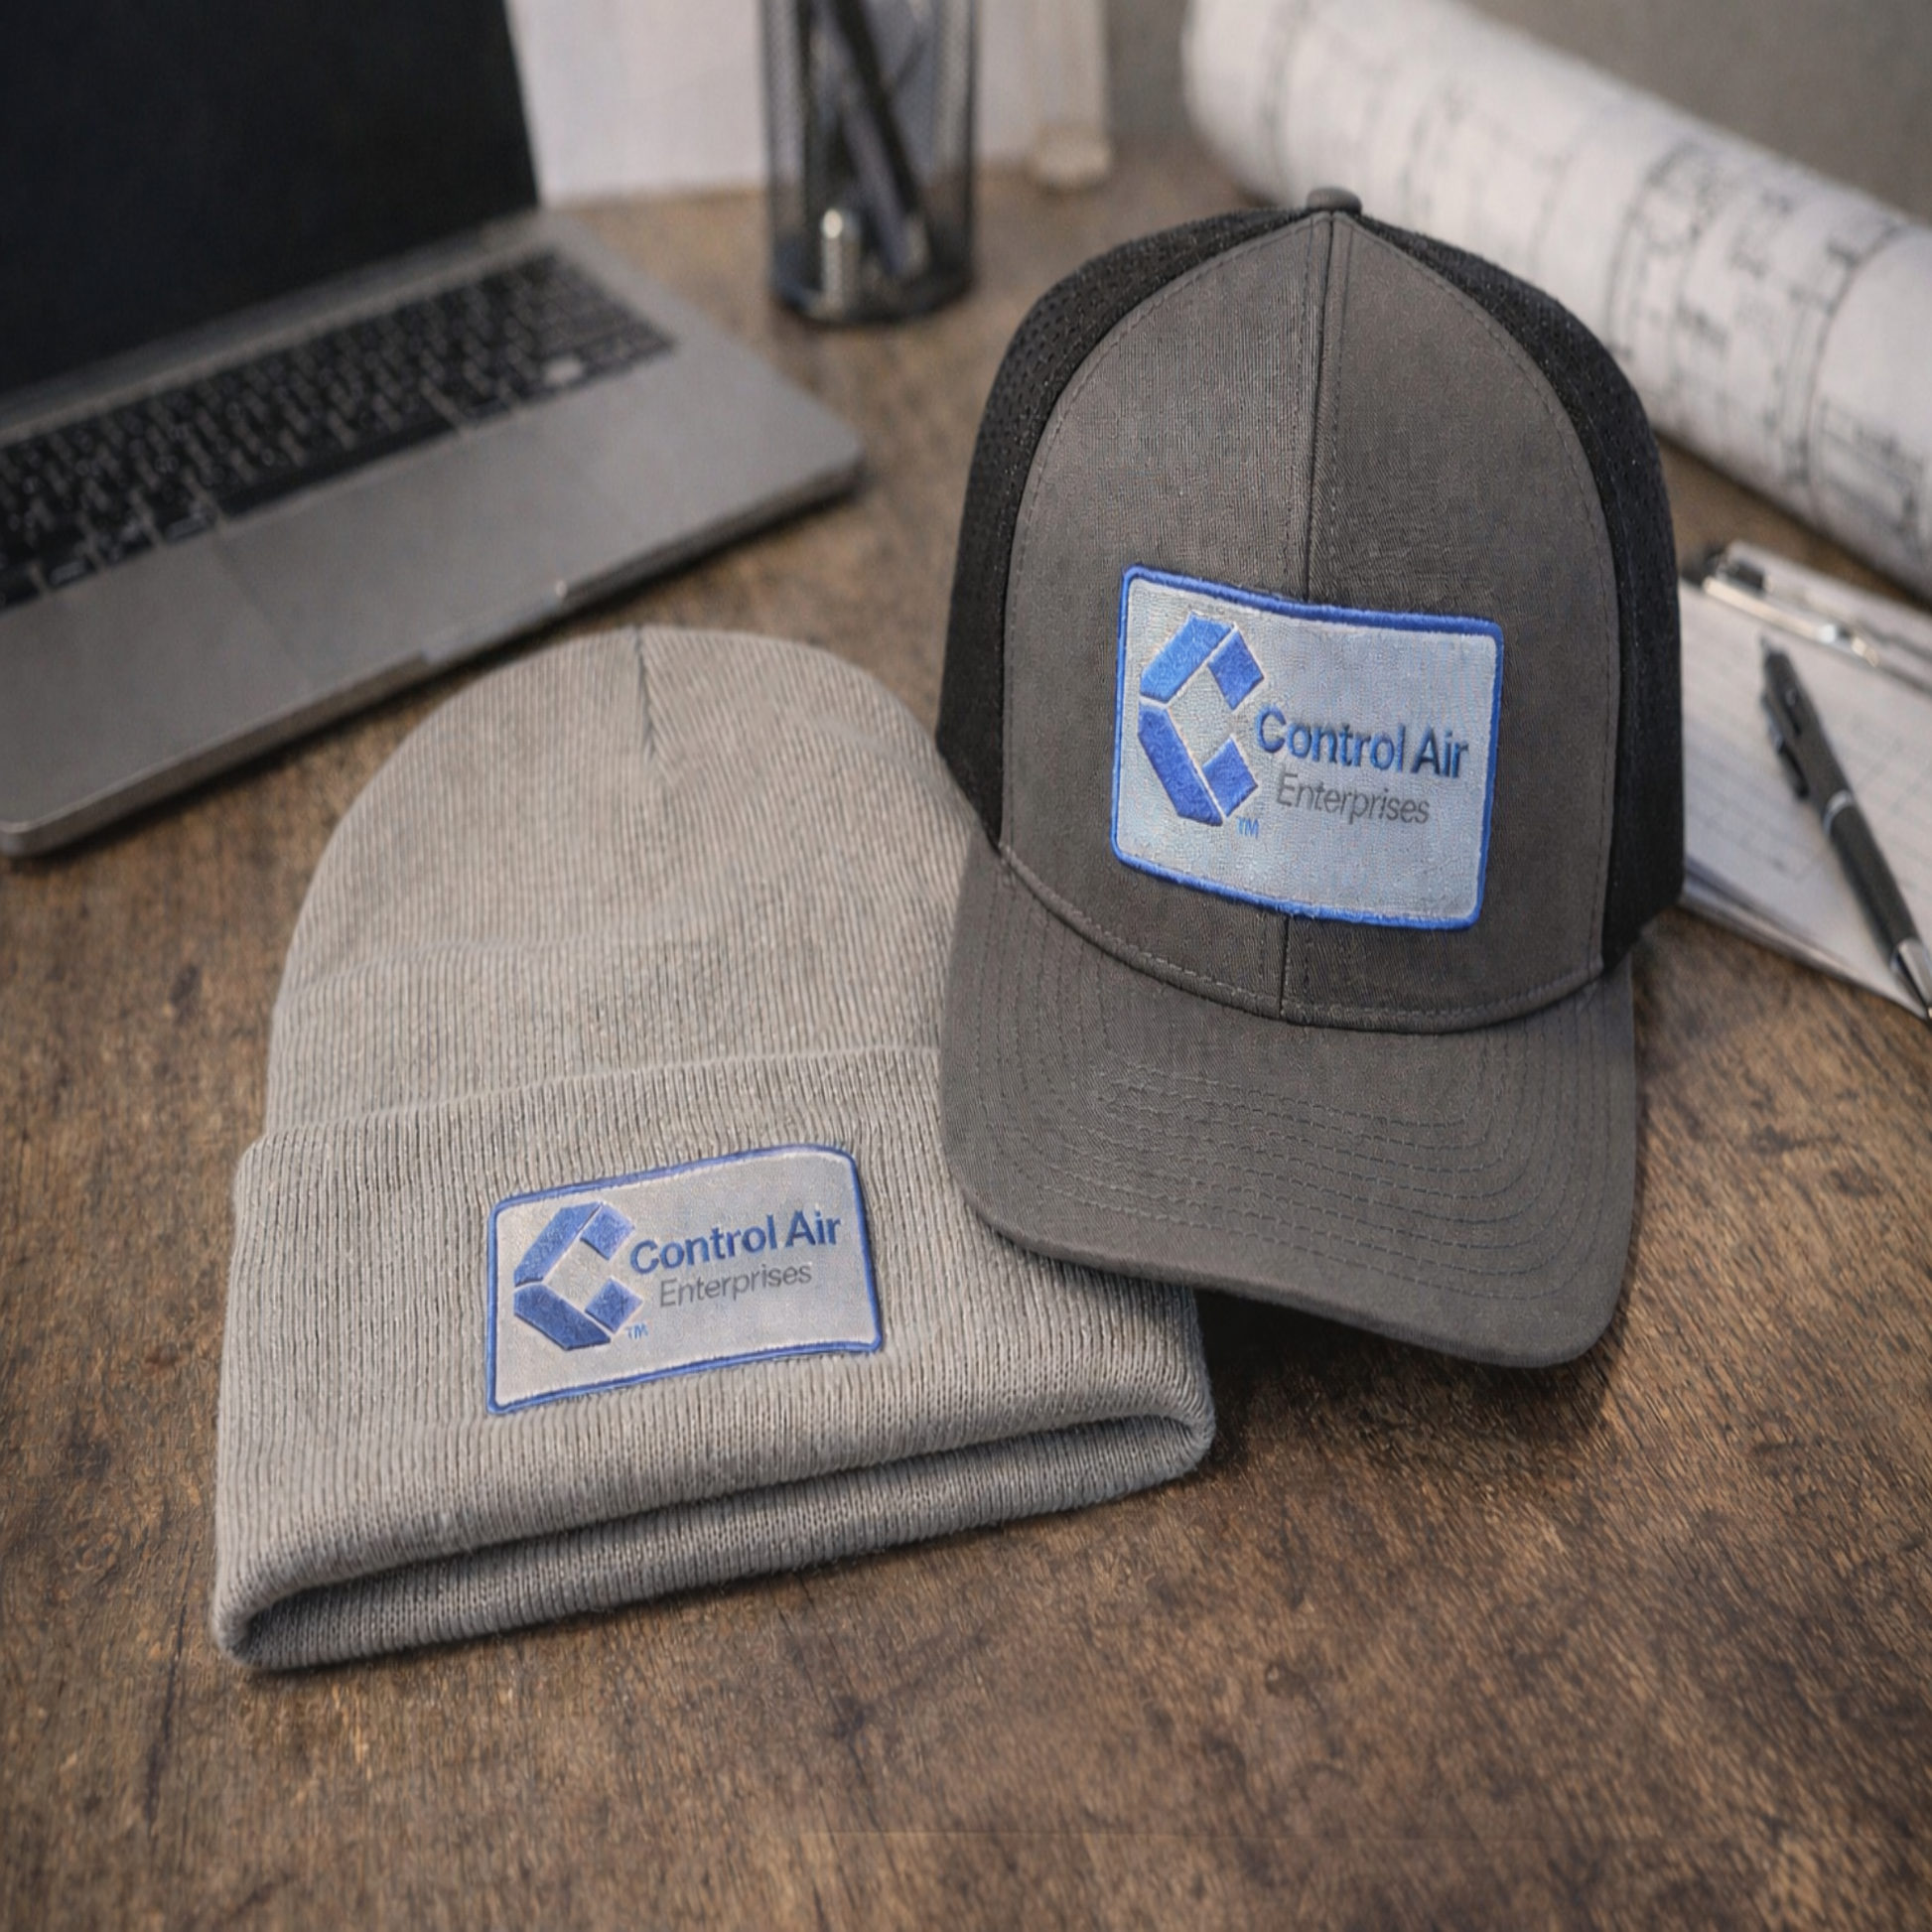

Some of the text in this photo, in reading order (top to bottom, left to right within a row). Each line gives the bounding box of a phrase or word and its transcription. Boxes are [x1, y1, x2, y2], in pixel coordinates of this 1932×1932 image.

[1254, 704, 1469, 778] Control Air
[1277, 768, 1430, 824] Enterprises
[629, 1208, 841, 1275] Control Air
[659, 1263, 812, 1308] Enterprises
